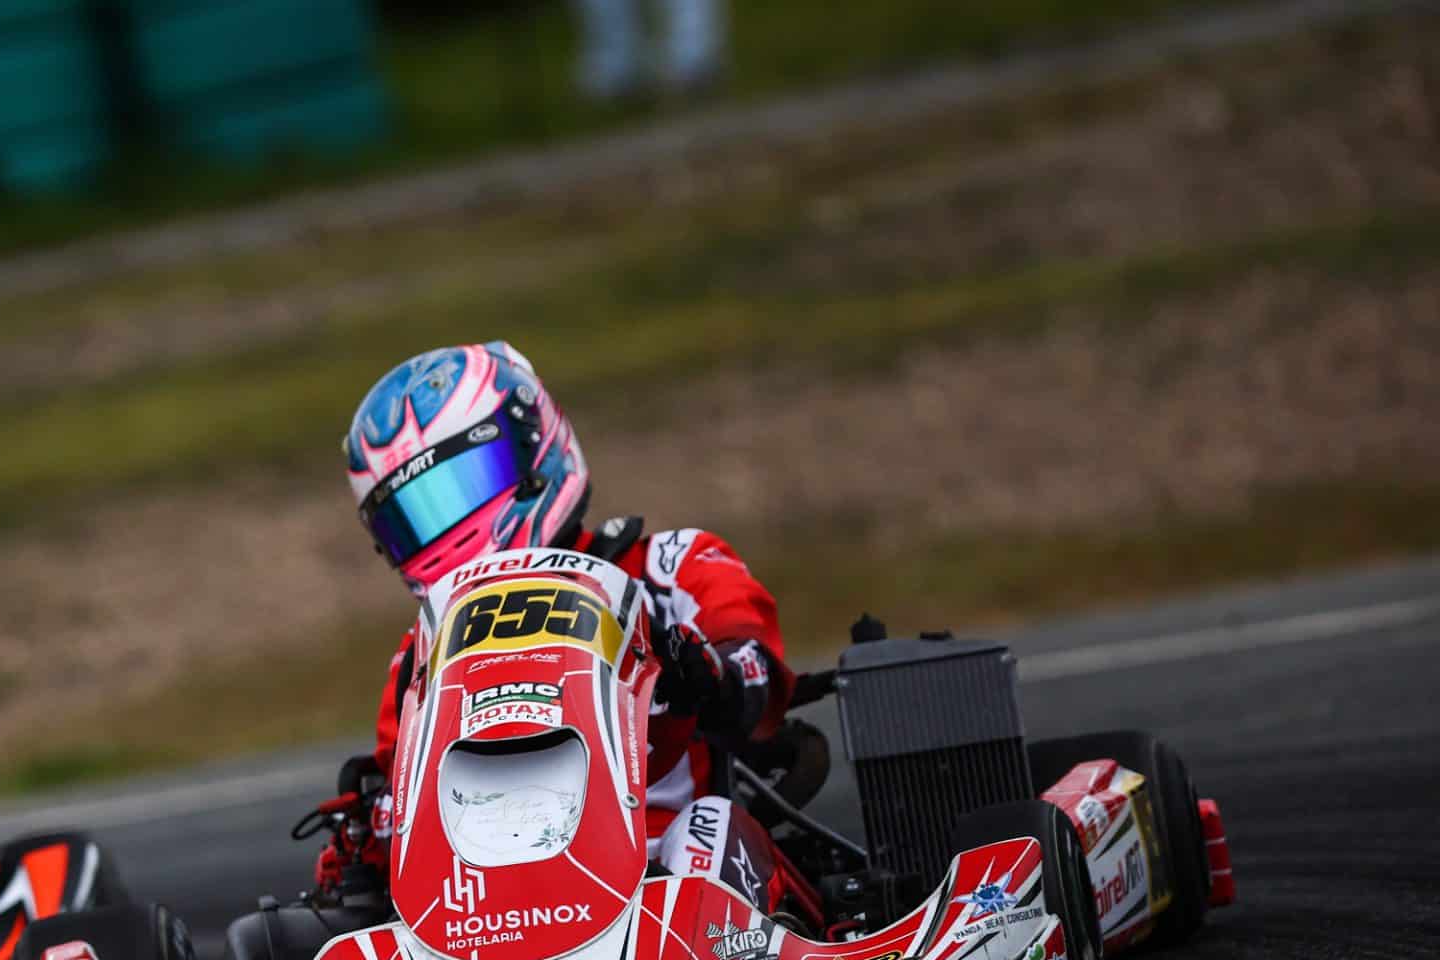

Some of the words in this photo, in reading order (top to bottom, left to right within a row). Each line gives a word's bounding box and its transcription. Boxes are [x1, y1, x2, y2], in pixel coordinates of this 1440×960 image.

[453, 552, 604, 588] birelART
[445, 588, 601, 660] 655
[475, 683, 560, 705] RMC
[468, 704, 553, 727] ROTAX
[446, 903, 593, 938] HOUSINOX
[447, 931, 524, 951] HOTELARIA
[725, 929, 768, 957] KIRO
